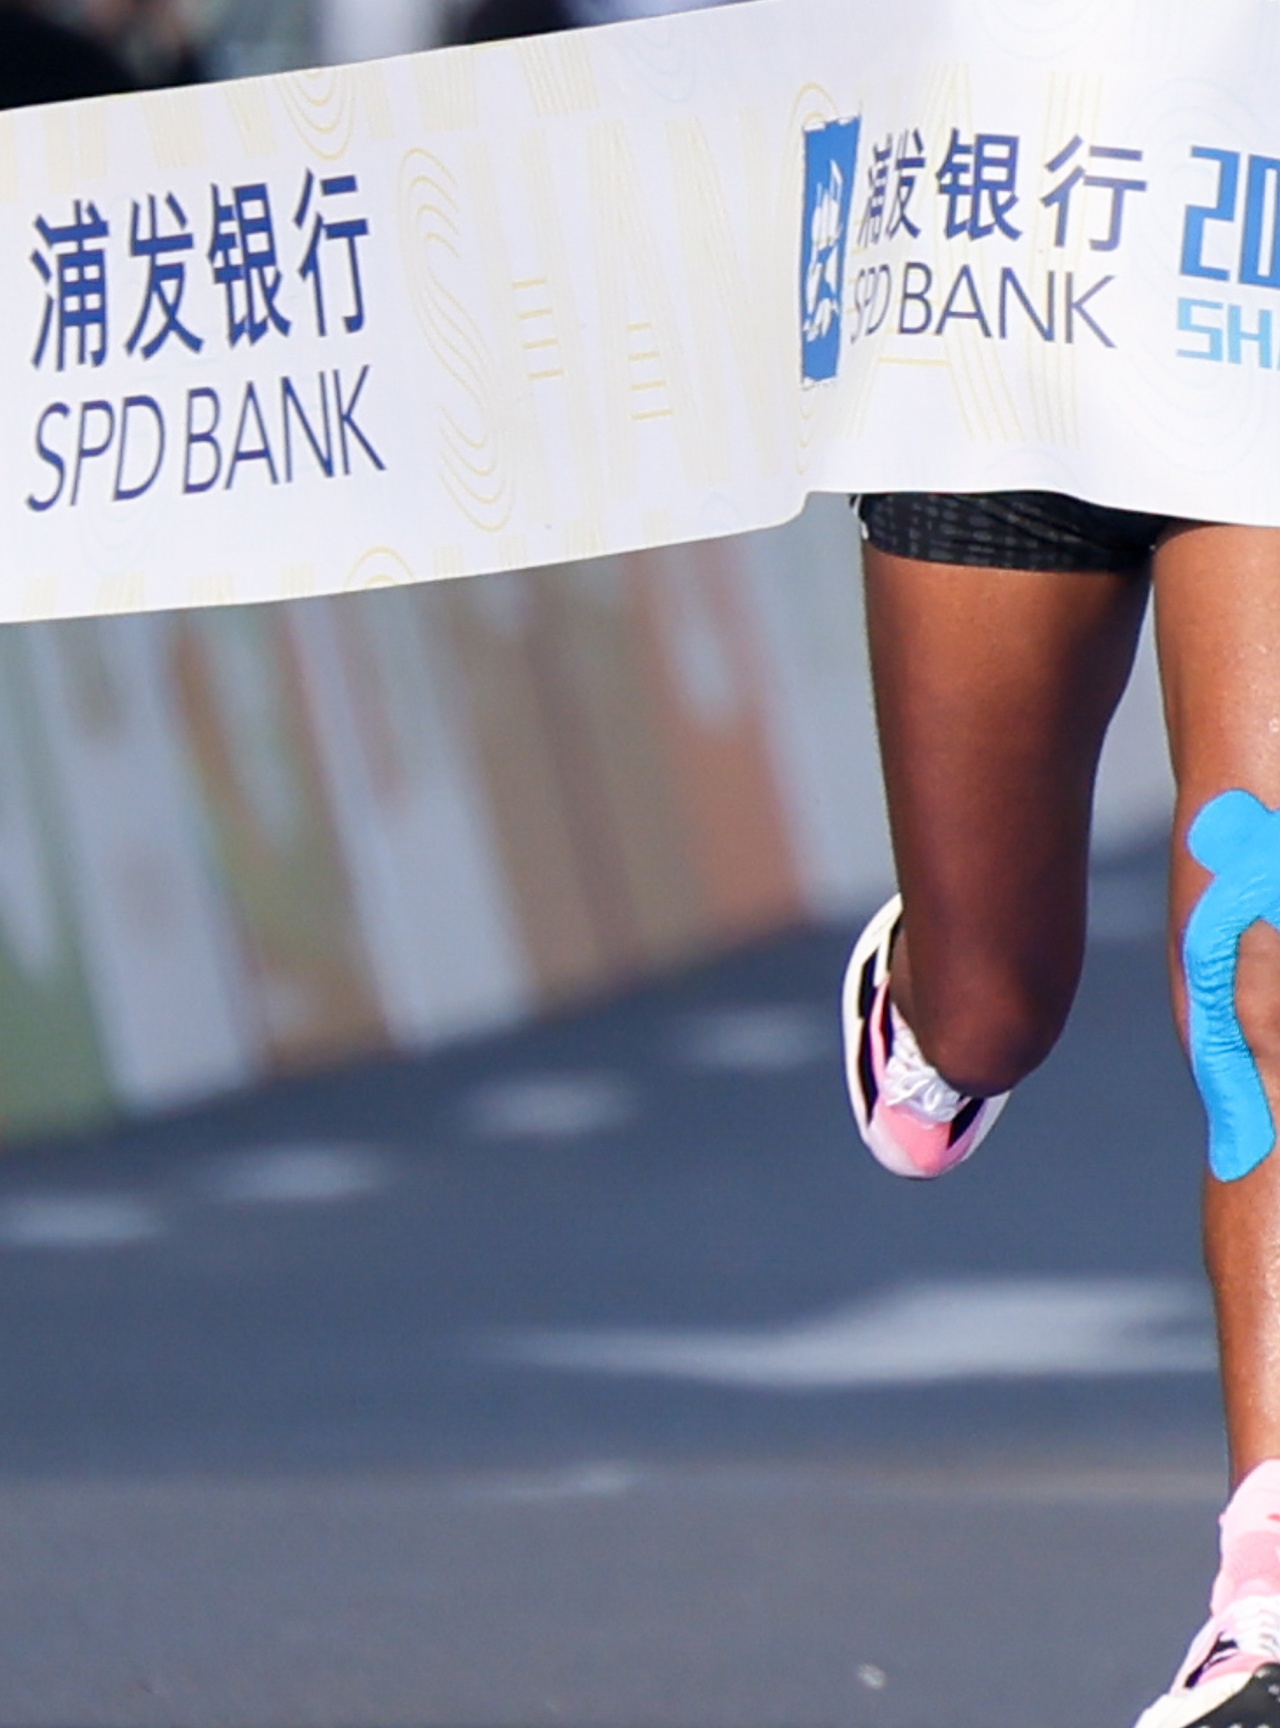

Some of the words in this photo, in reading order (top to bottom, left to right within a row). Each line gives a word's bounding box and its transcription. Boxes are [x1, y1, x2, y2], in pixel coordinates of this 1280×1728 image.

[857, 127, 1147, 252] 浦发银行
[30, 168, 369, 372] 浦发银行
[897, 261, 1117, 349] BANK
[26, 395, 165, 512] SPD
[182, 365, 387, 494] BANK
